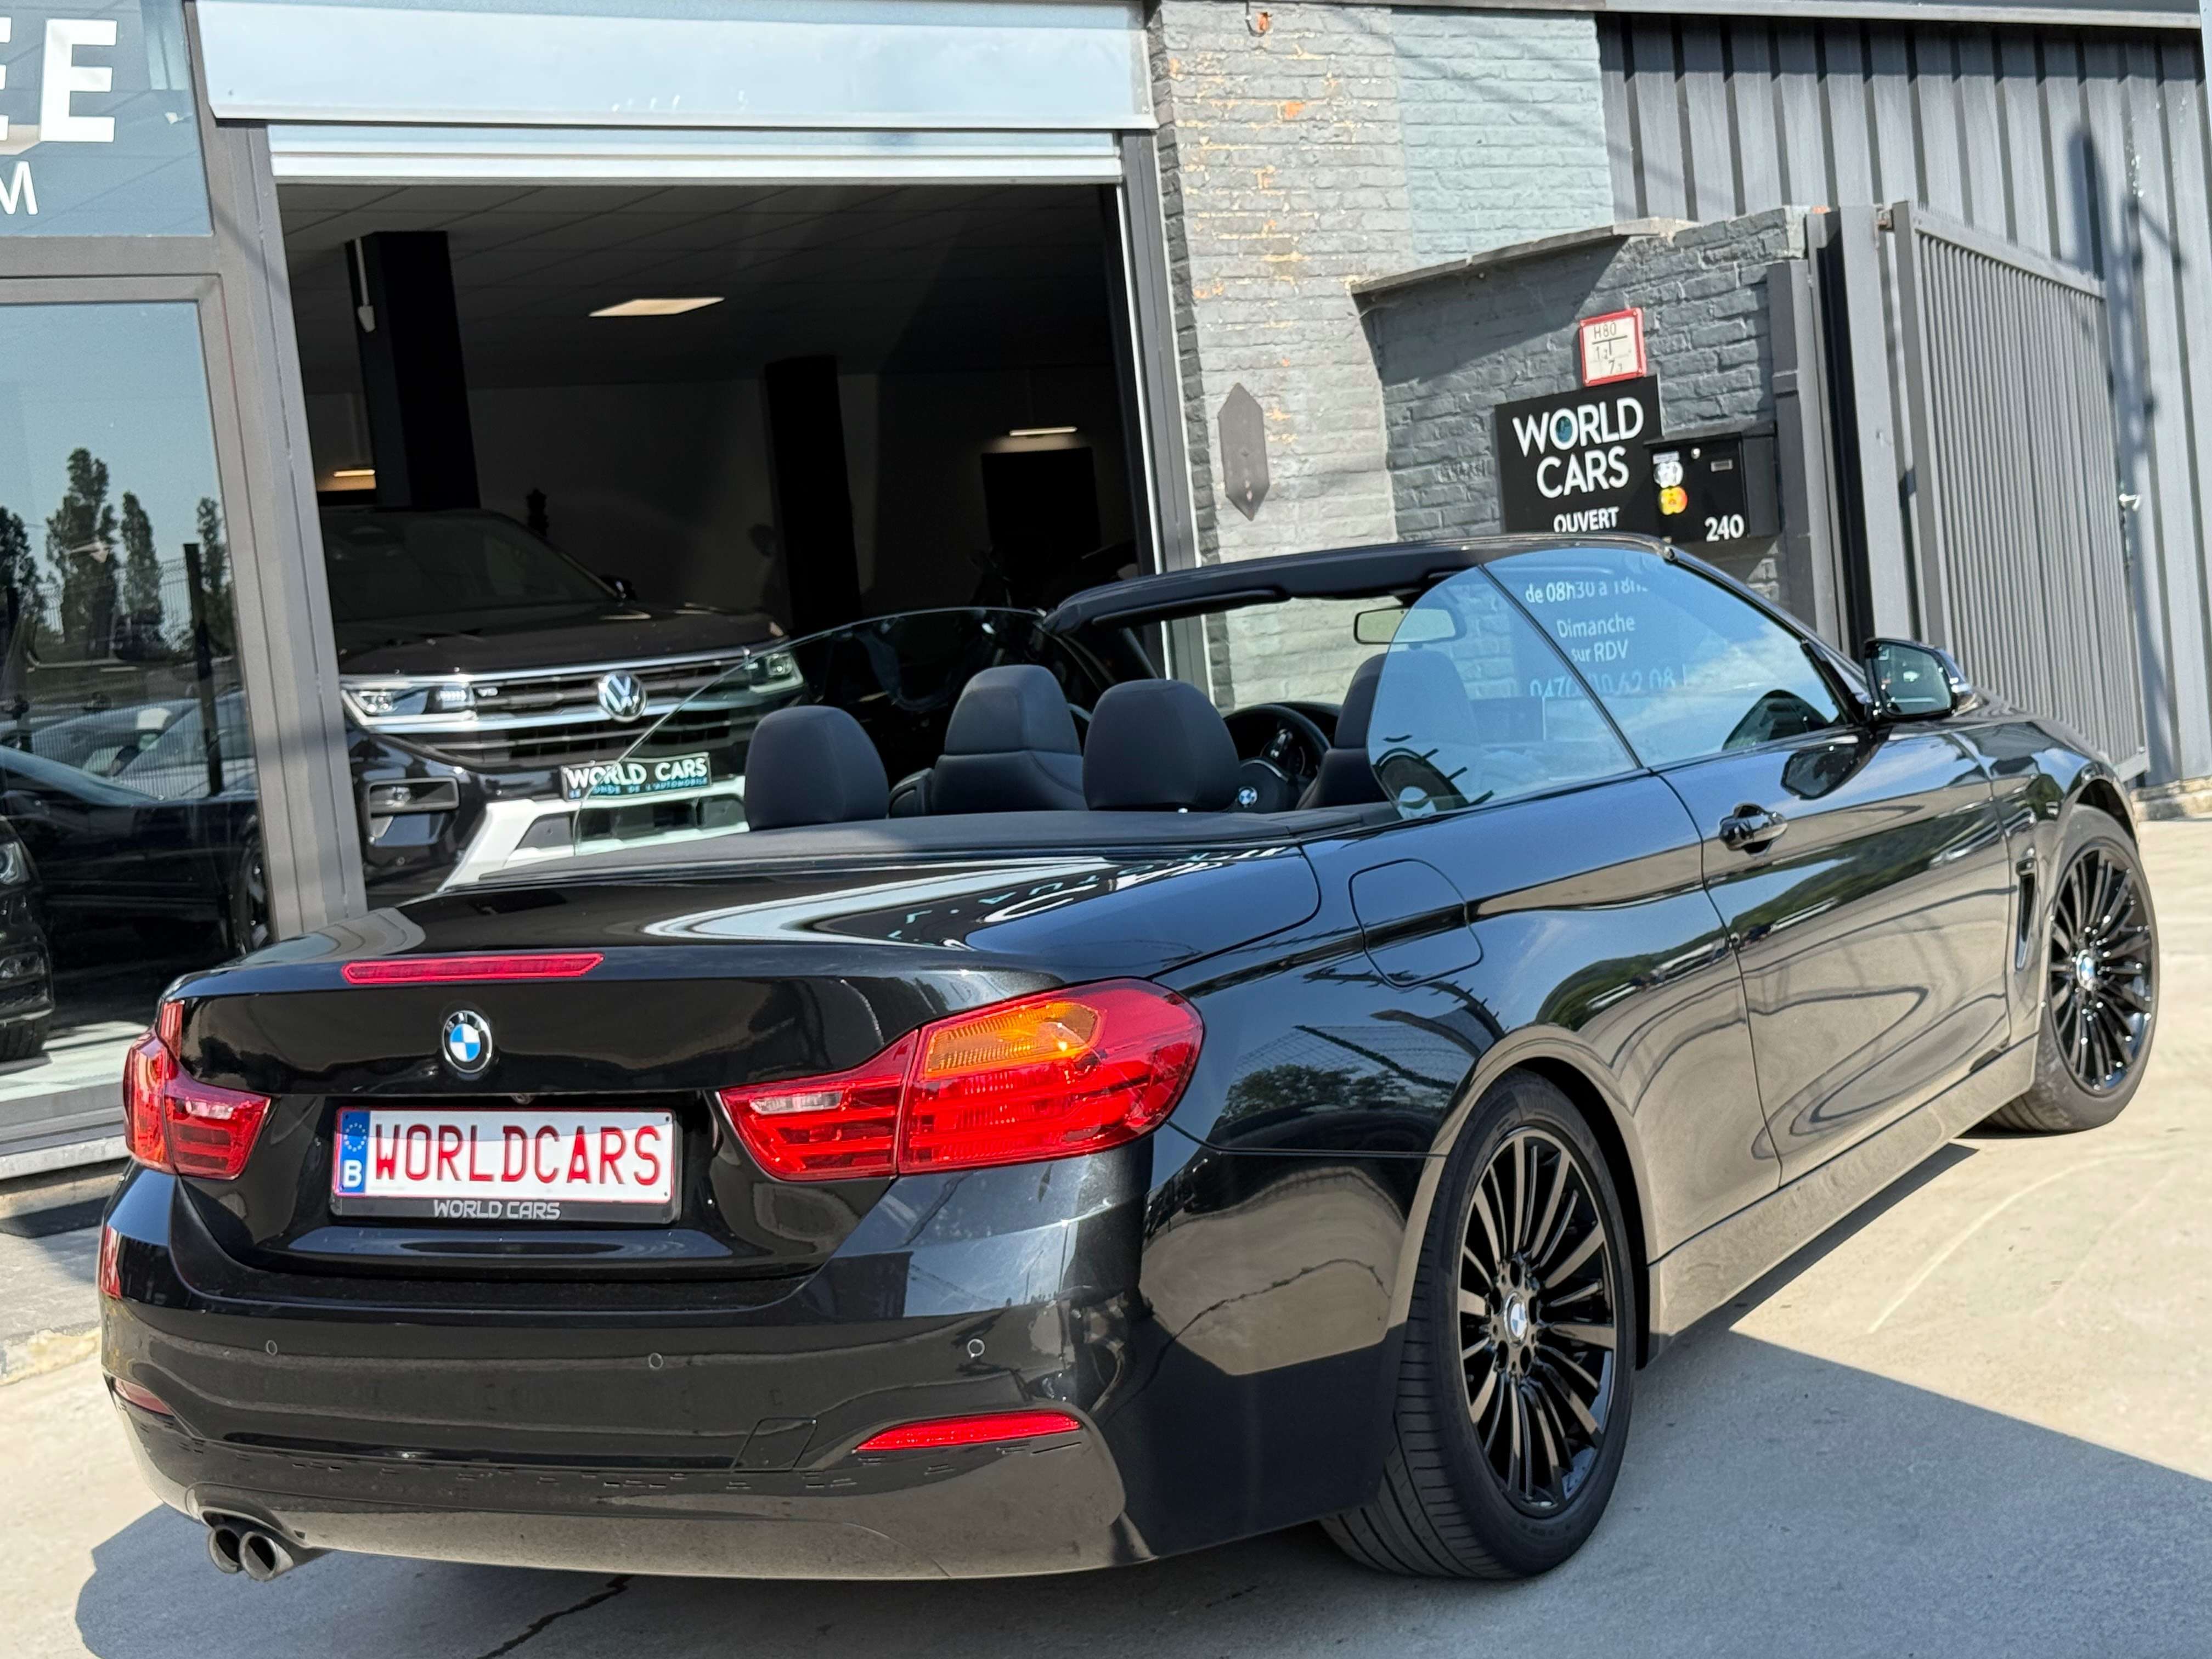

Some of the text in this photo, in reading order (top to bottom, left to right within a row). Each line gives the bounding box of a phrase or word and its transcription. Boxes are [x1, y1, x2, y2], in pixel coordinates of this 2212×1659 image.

[1512, 397, 1644, 458] WORLD
[1537, 445, 1629, 498] CARS
[1553, 506, 1620, 533] OUVERT
[1705, 514, 1745, 542] 240
[1525, 583, 1544, 603] de
[1556, 611, 1636, 638] Dimanche
[1571, 639, 1629, 662] sur RDV
[565, 758, 707, 789] WORLD CARS
[343, 1123, 662, 1188] B WORLDCARS
[433, 1200, 561, 1220] WORLD CARS
